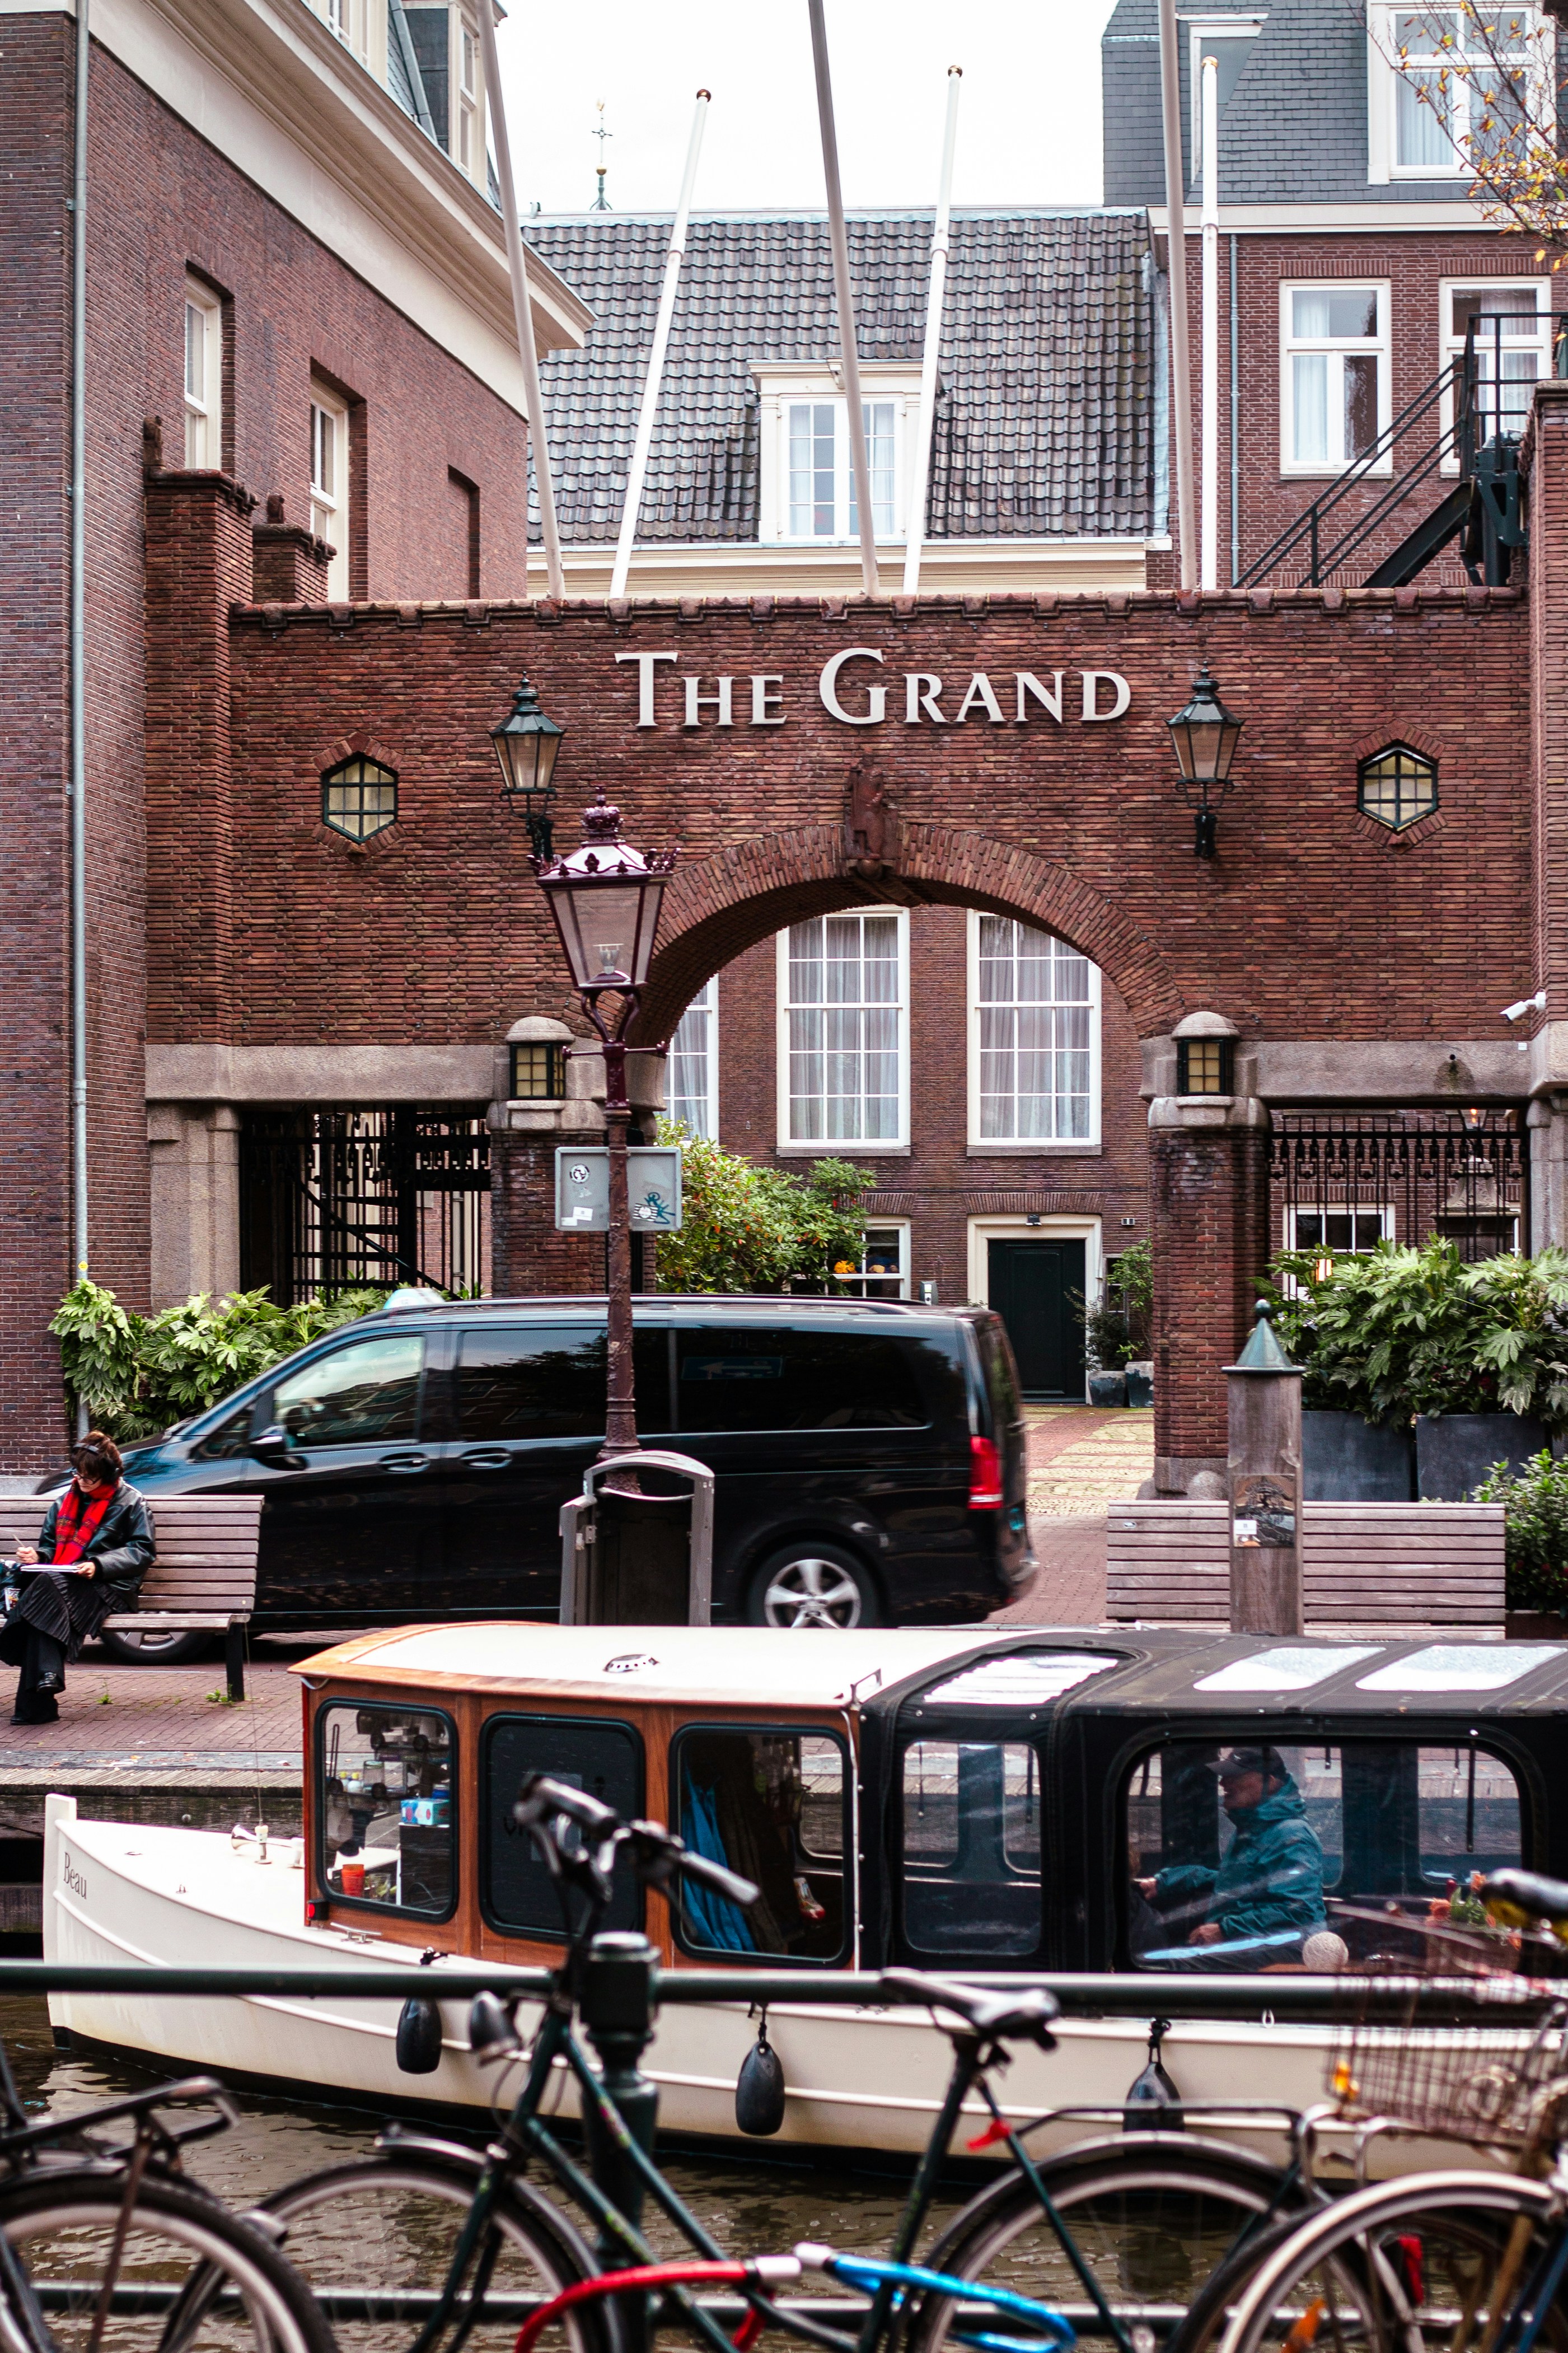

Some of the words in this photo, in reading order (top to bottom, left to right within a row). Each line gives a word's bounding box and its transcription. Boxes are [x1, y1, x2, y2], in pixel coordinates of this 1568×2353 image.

[614, 651, 788, 727] THE
[818, 647, 1131, 725] GRAND
[63, 1851, 87, 1899] Beau
